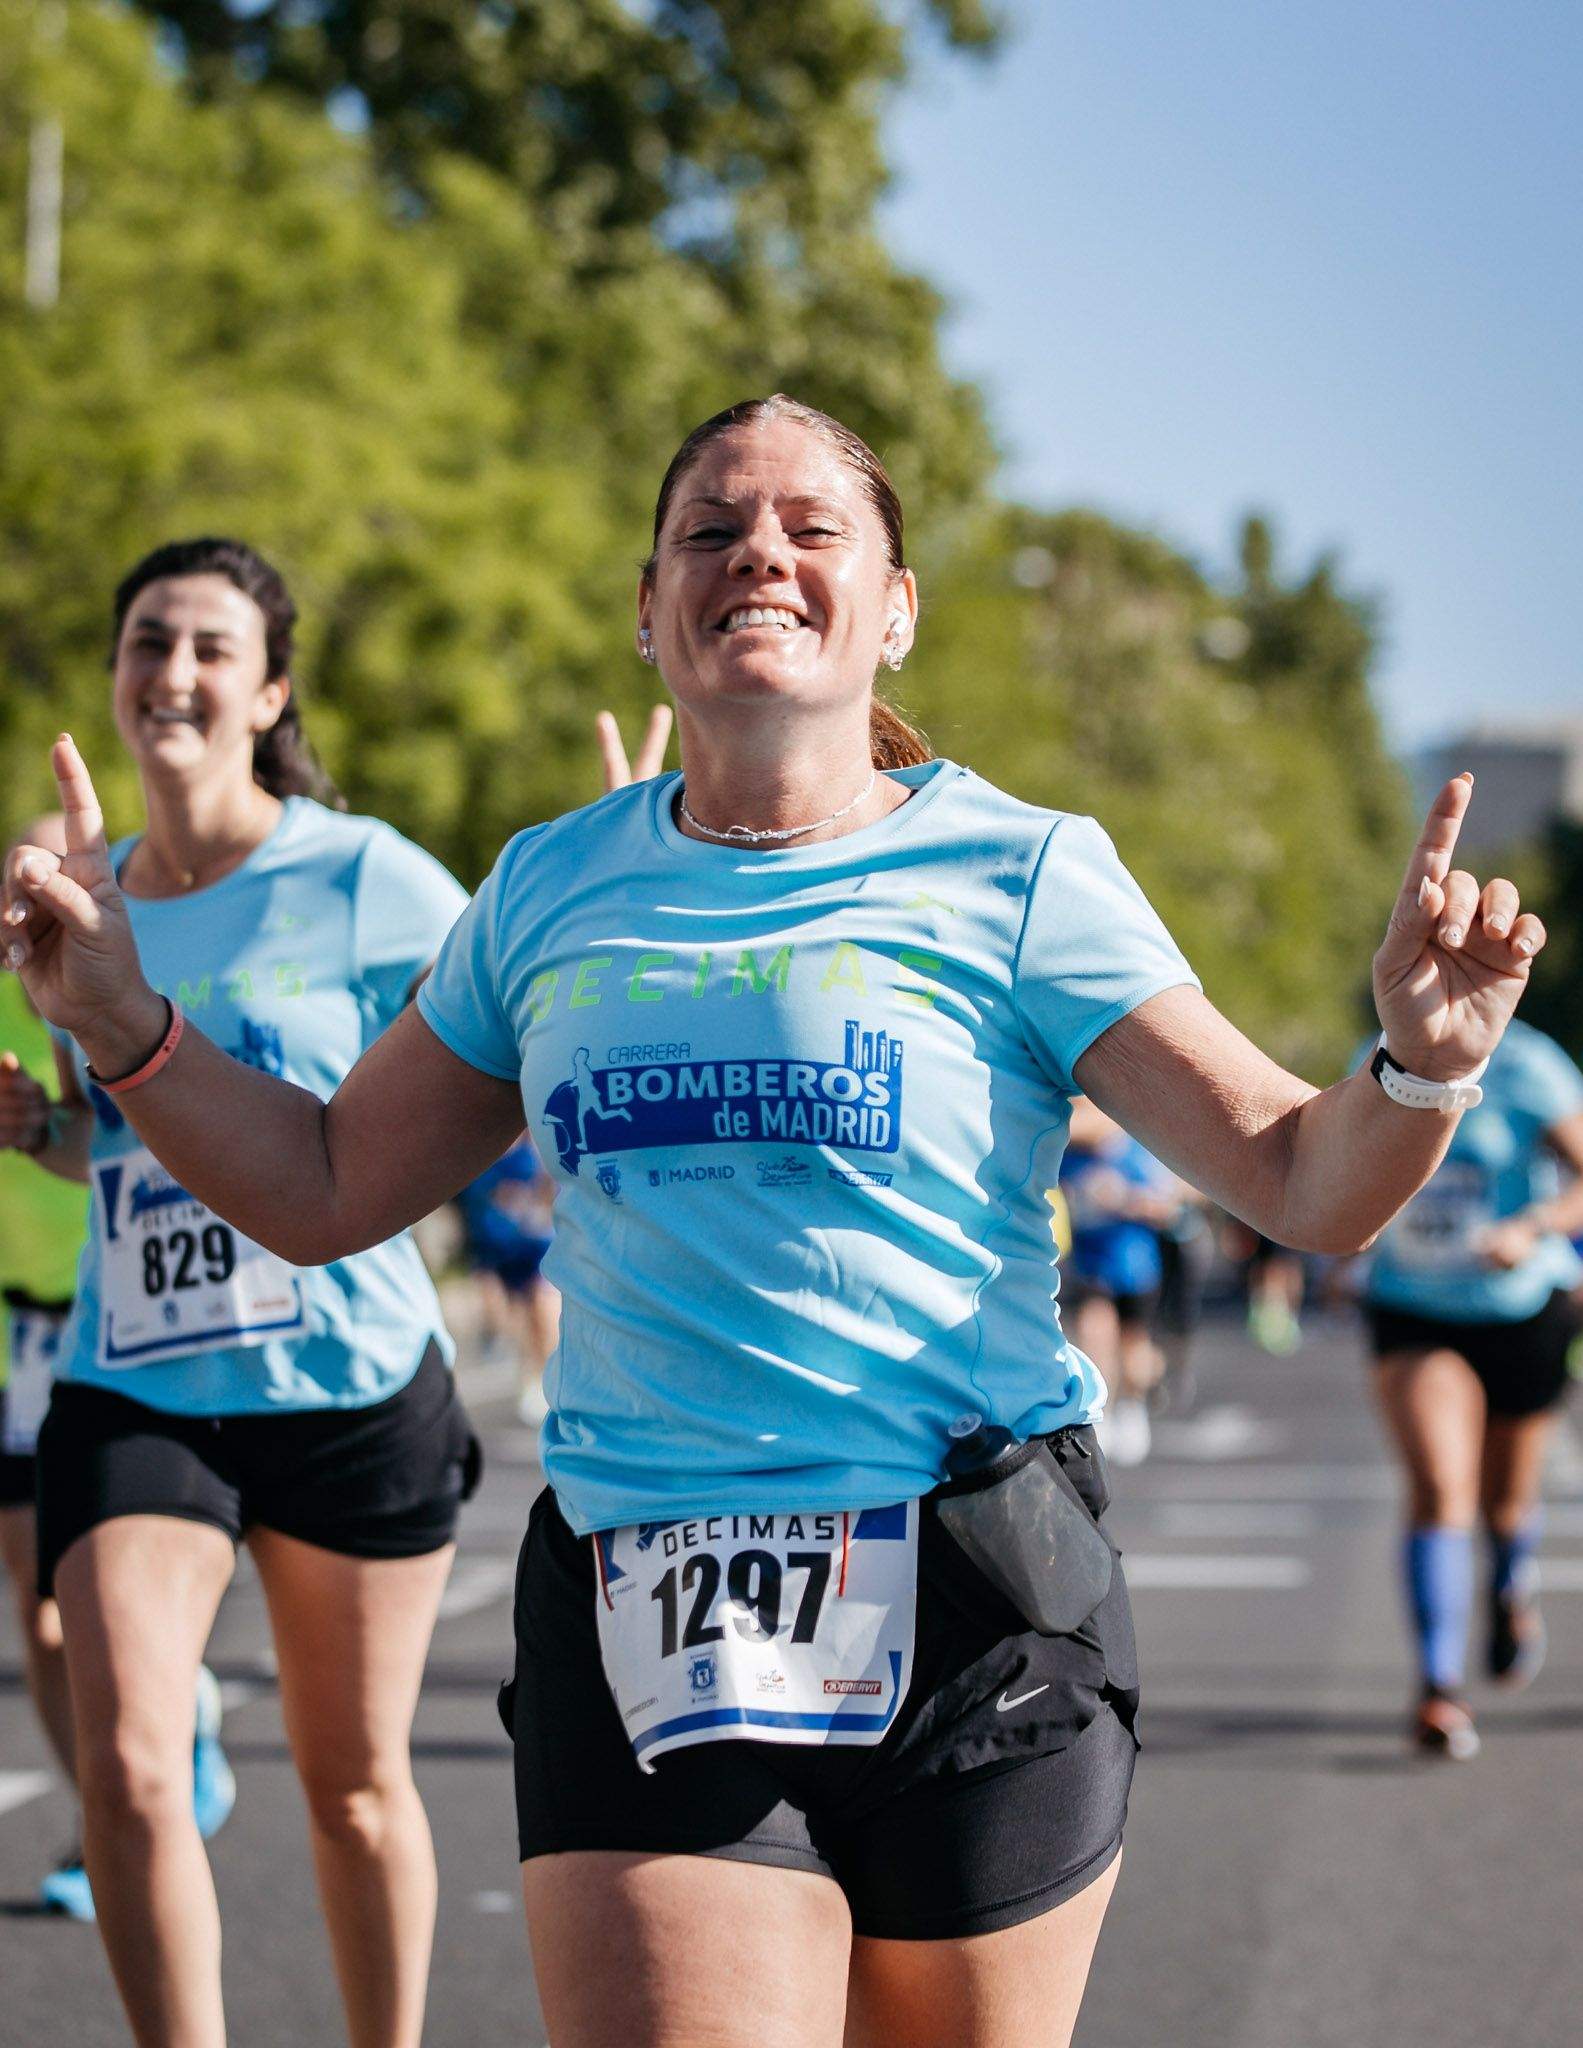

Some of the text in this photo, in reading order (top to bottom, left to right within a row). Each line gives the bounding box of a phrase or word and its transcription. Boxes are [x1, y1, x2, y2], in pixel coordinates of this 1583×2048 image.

[529, 942, 943, 1024] DECIMAS
[607, 1042, 691, 1064] CARRERA
[606, 1063, 891, 1106] BOMBEROS
[714, 1102, 891, 1148] de MADRID
[668, 1164, 735, 1183] MADRID
[143, 1223, 237, 1296] 829
[662, 1515, 836, 1558] DECIMAS
[651, 1549, 831, 1660] 1297
